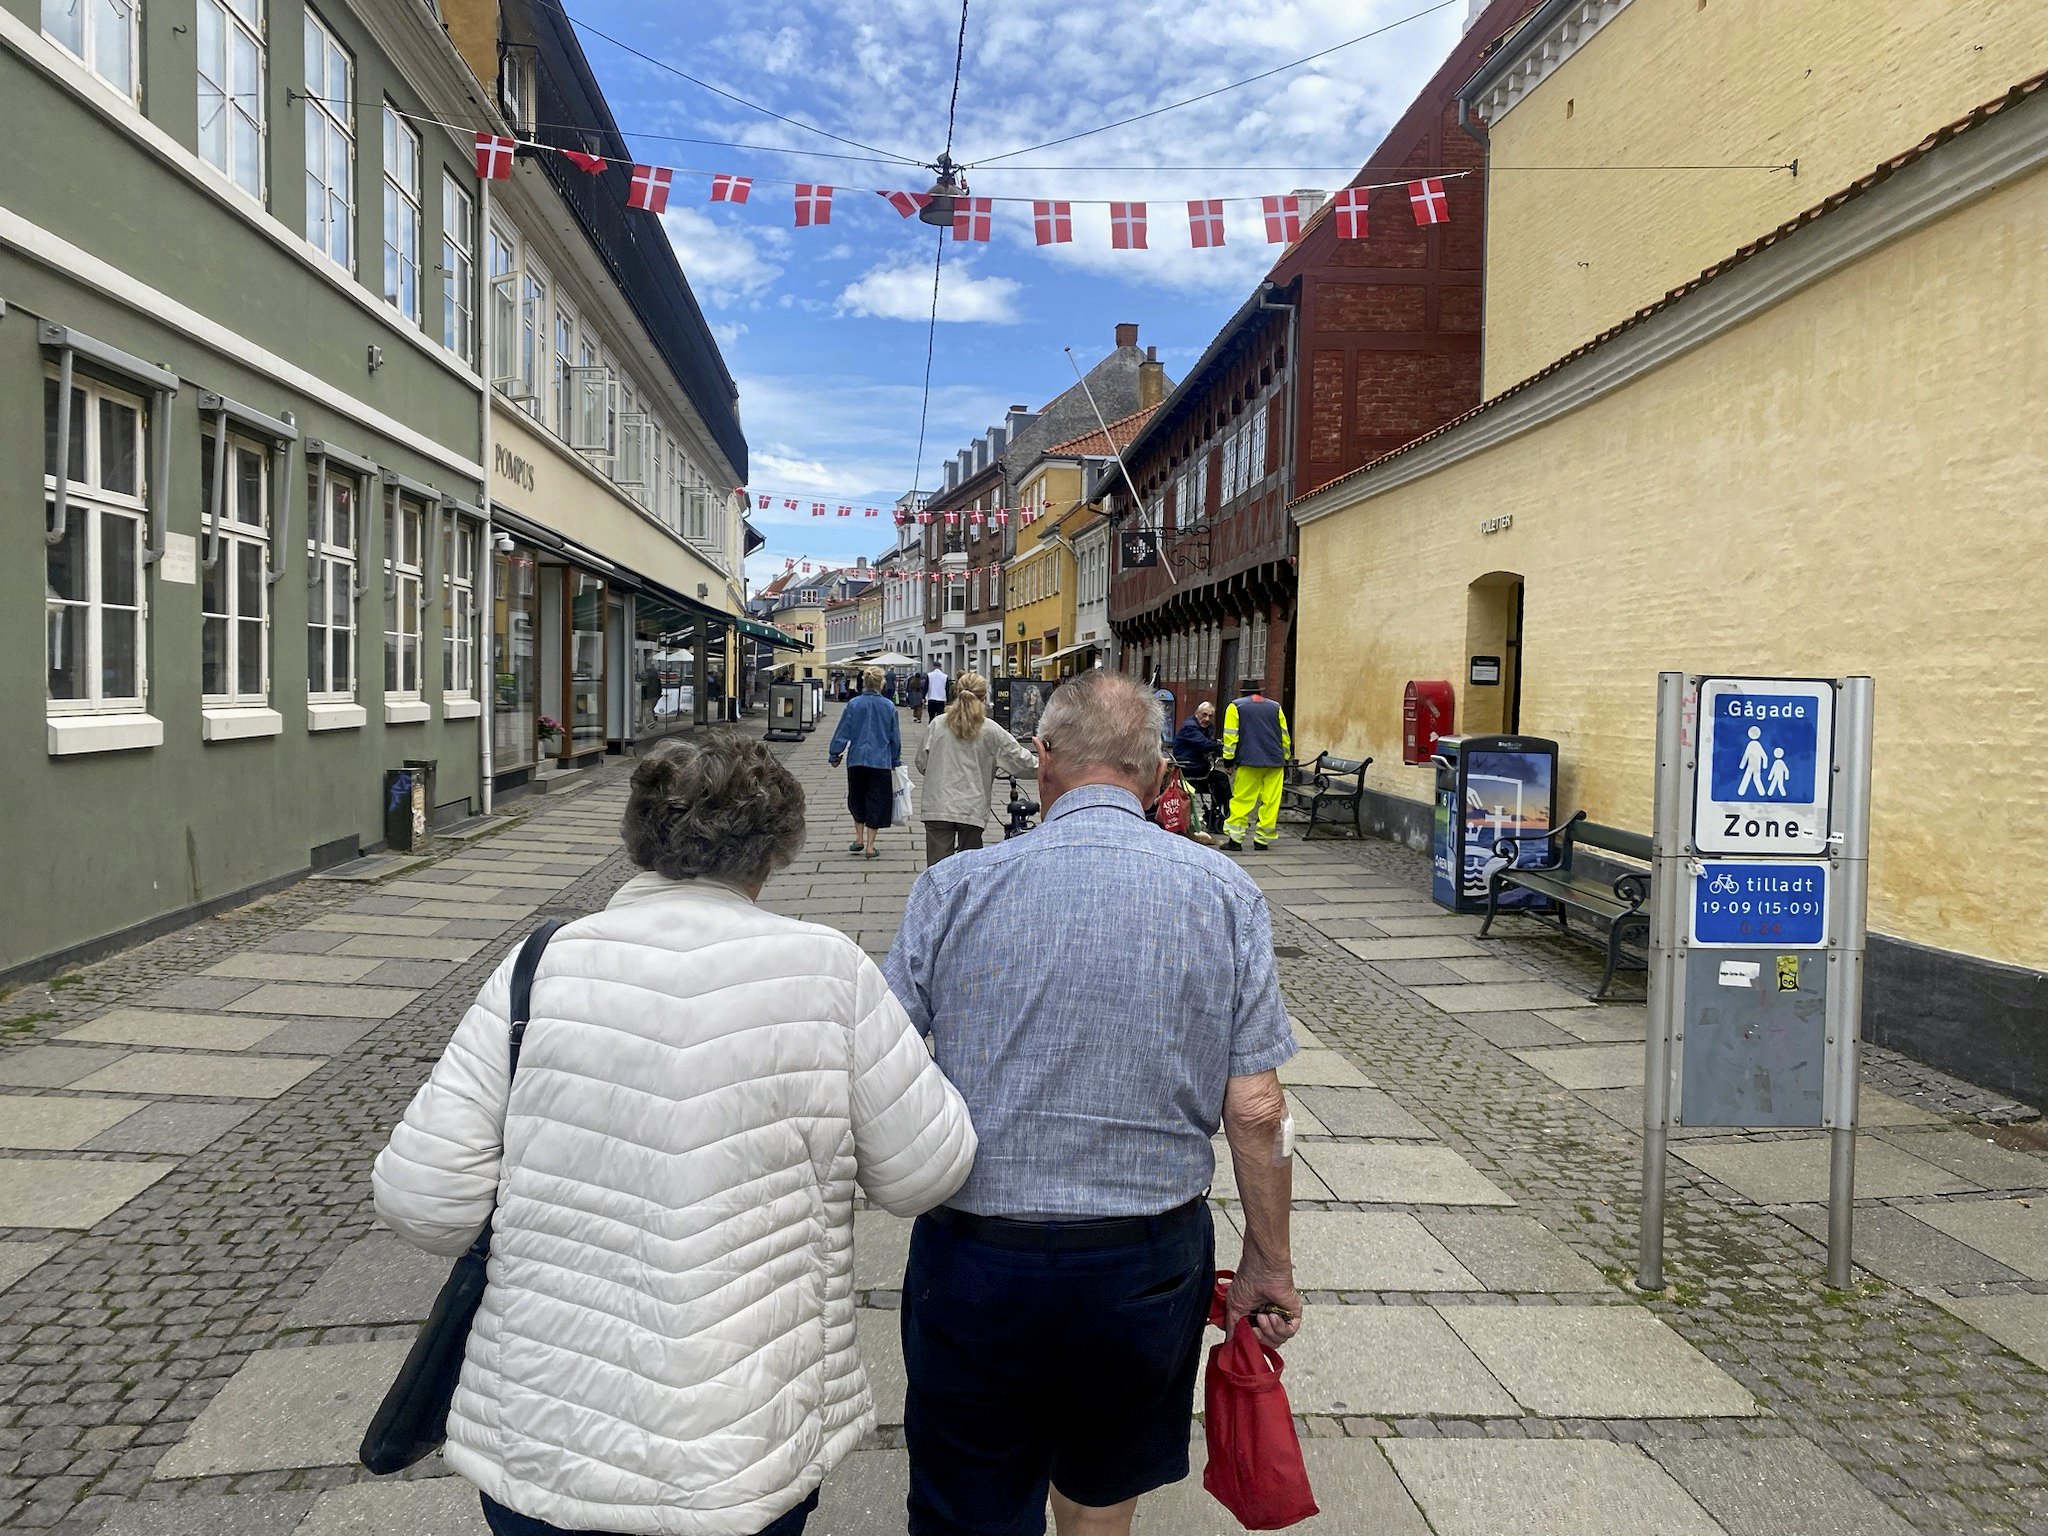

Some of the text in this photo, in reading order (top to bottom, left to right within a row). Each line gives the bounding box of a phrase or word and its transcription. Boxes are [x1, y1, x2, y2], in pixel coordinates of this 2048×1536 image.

[495, 442, 534, 492] POMPUS
[1728, 700, 1805, 720] Gågade
[1724, 814, 1799, 838] Zone
[1747, 877, 1813, 892] tilladt
[1702, 901, 1819, 916] 19-09 (15-09)
